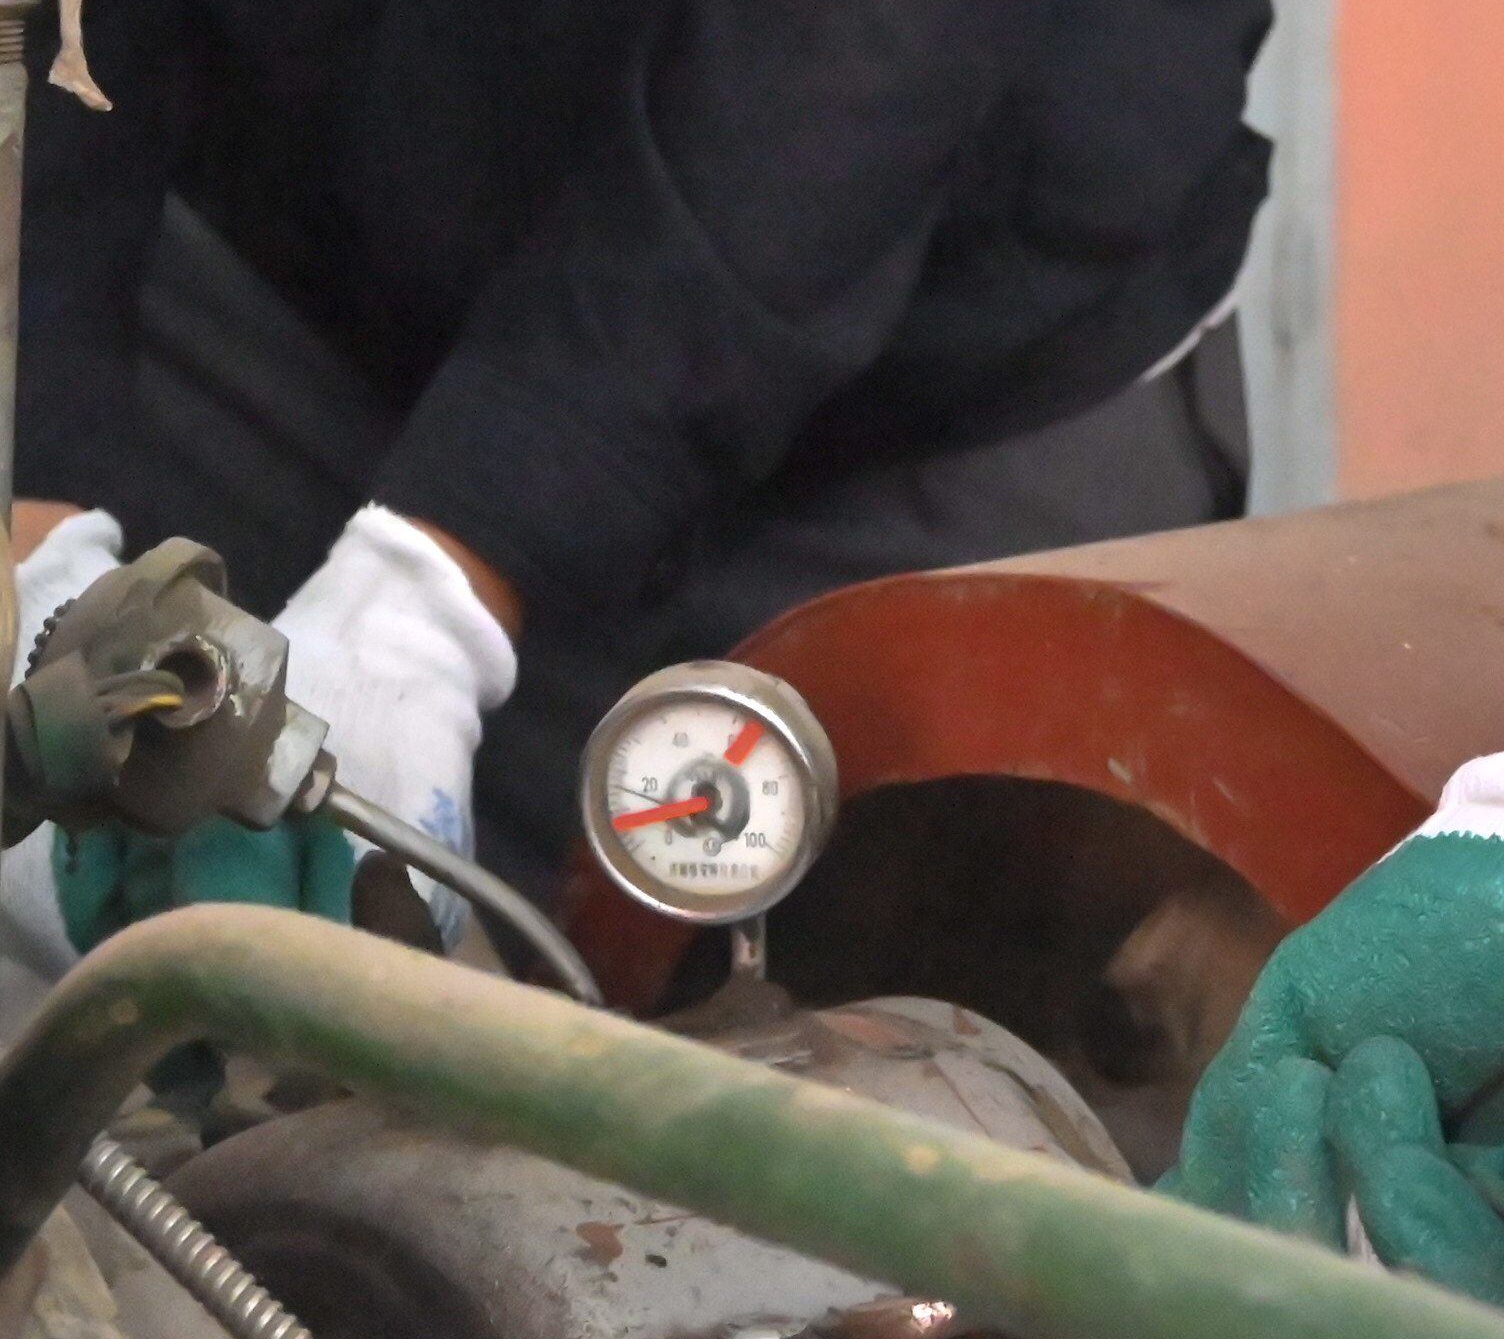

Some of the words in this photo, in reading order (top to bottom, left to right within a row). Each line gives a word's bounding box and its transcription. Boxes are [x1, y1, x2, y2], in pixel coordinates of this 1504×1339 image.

[672, 732, 689, 748] 40
[641, 777, 658, 793] 20
[762, 780, 779, 796] 80
[744, 832, 767, 848] 100
